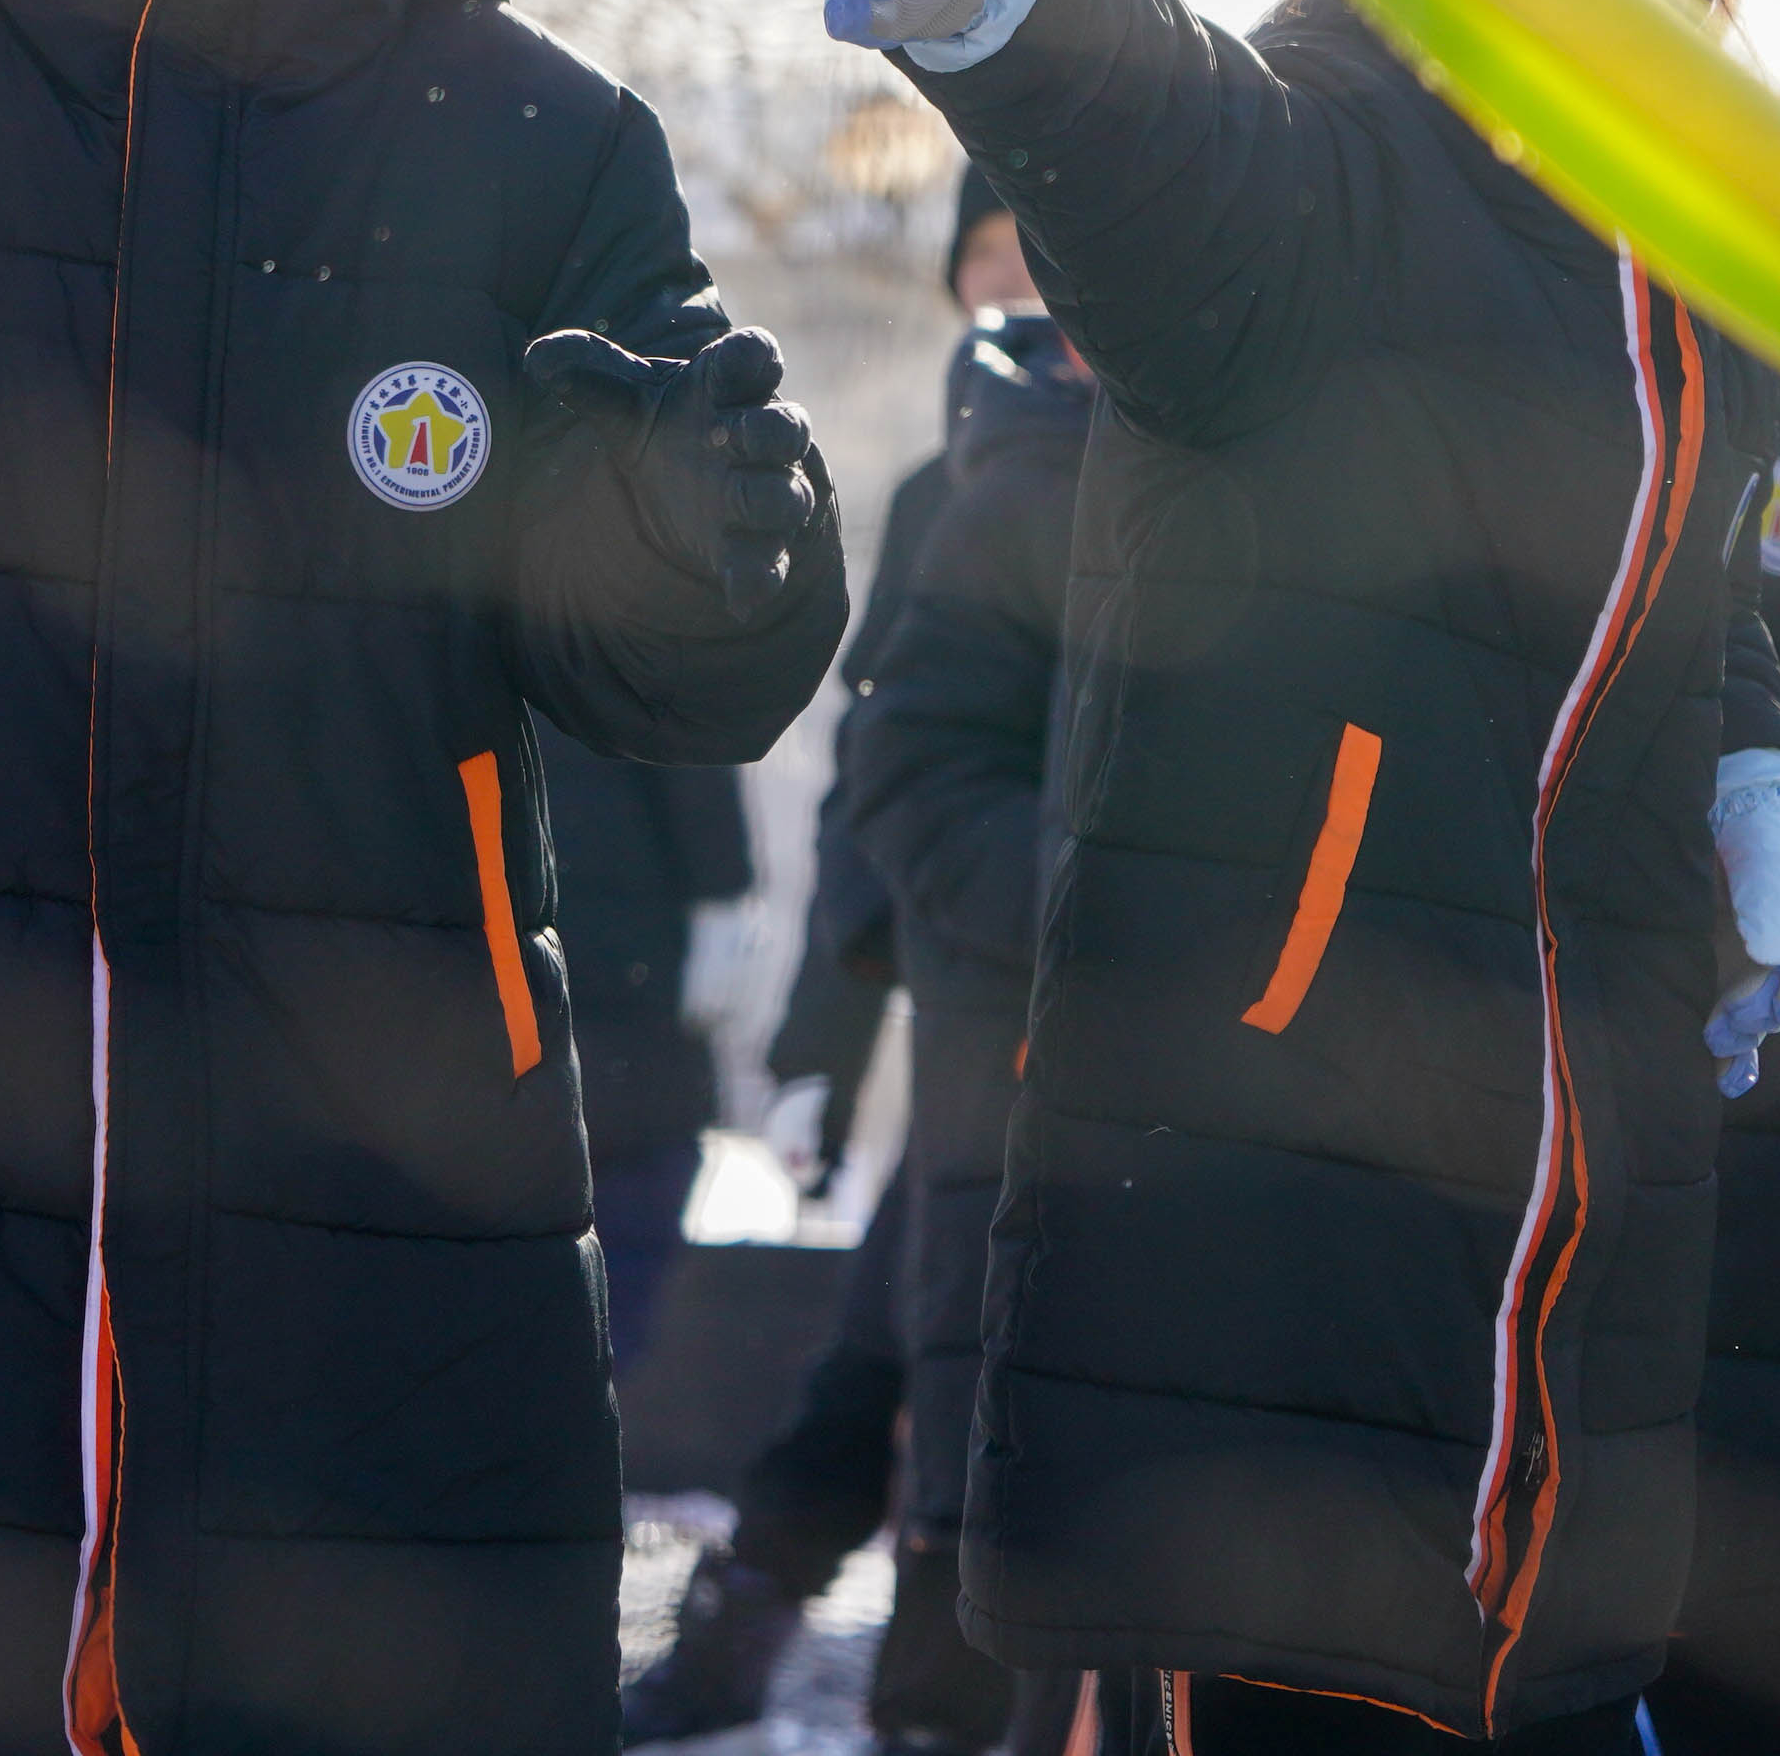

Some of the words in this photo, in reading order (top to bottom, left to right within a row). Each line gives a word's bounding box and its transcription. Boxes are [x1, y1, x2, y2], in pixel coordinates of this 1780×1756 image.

[380, 475, 441, 498] EXPERIMENTAL
[442, 464, 472, 493] PRIMARY
[470, 428, 481, 460] SCHOOL
